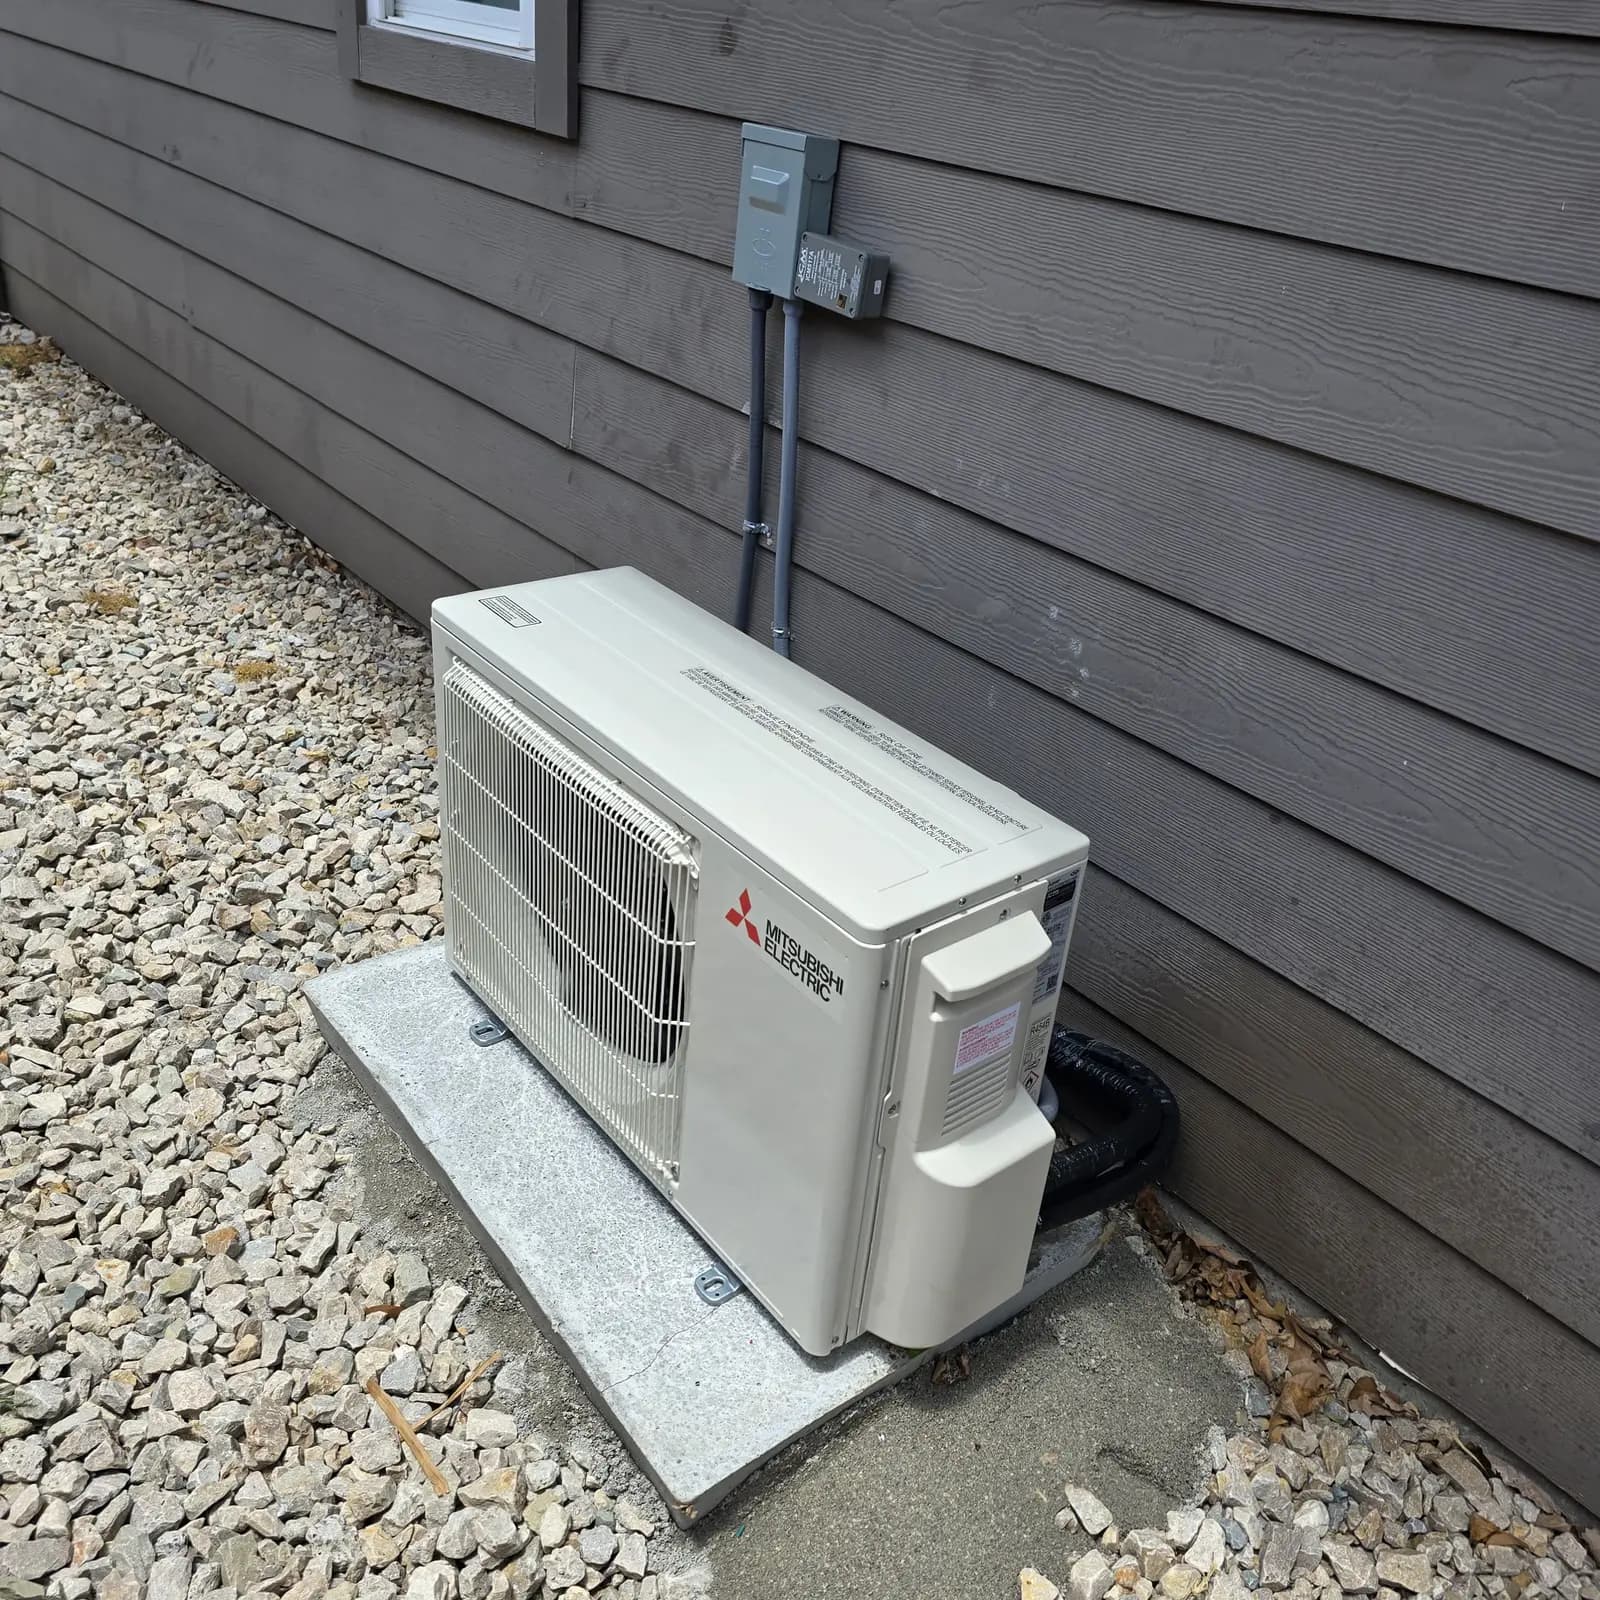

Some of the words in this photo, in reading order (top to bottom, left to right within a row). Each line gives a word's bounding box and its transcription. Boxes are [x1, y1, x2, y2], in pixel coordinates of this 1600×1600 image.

[840, 709, 871, 729] WARNING
[764, 936, 831, 1002] ELECTRIC
[766, 919, 844, 996] MITSUBISHI
